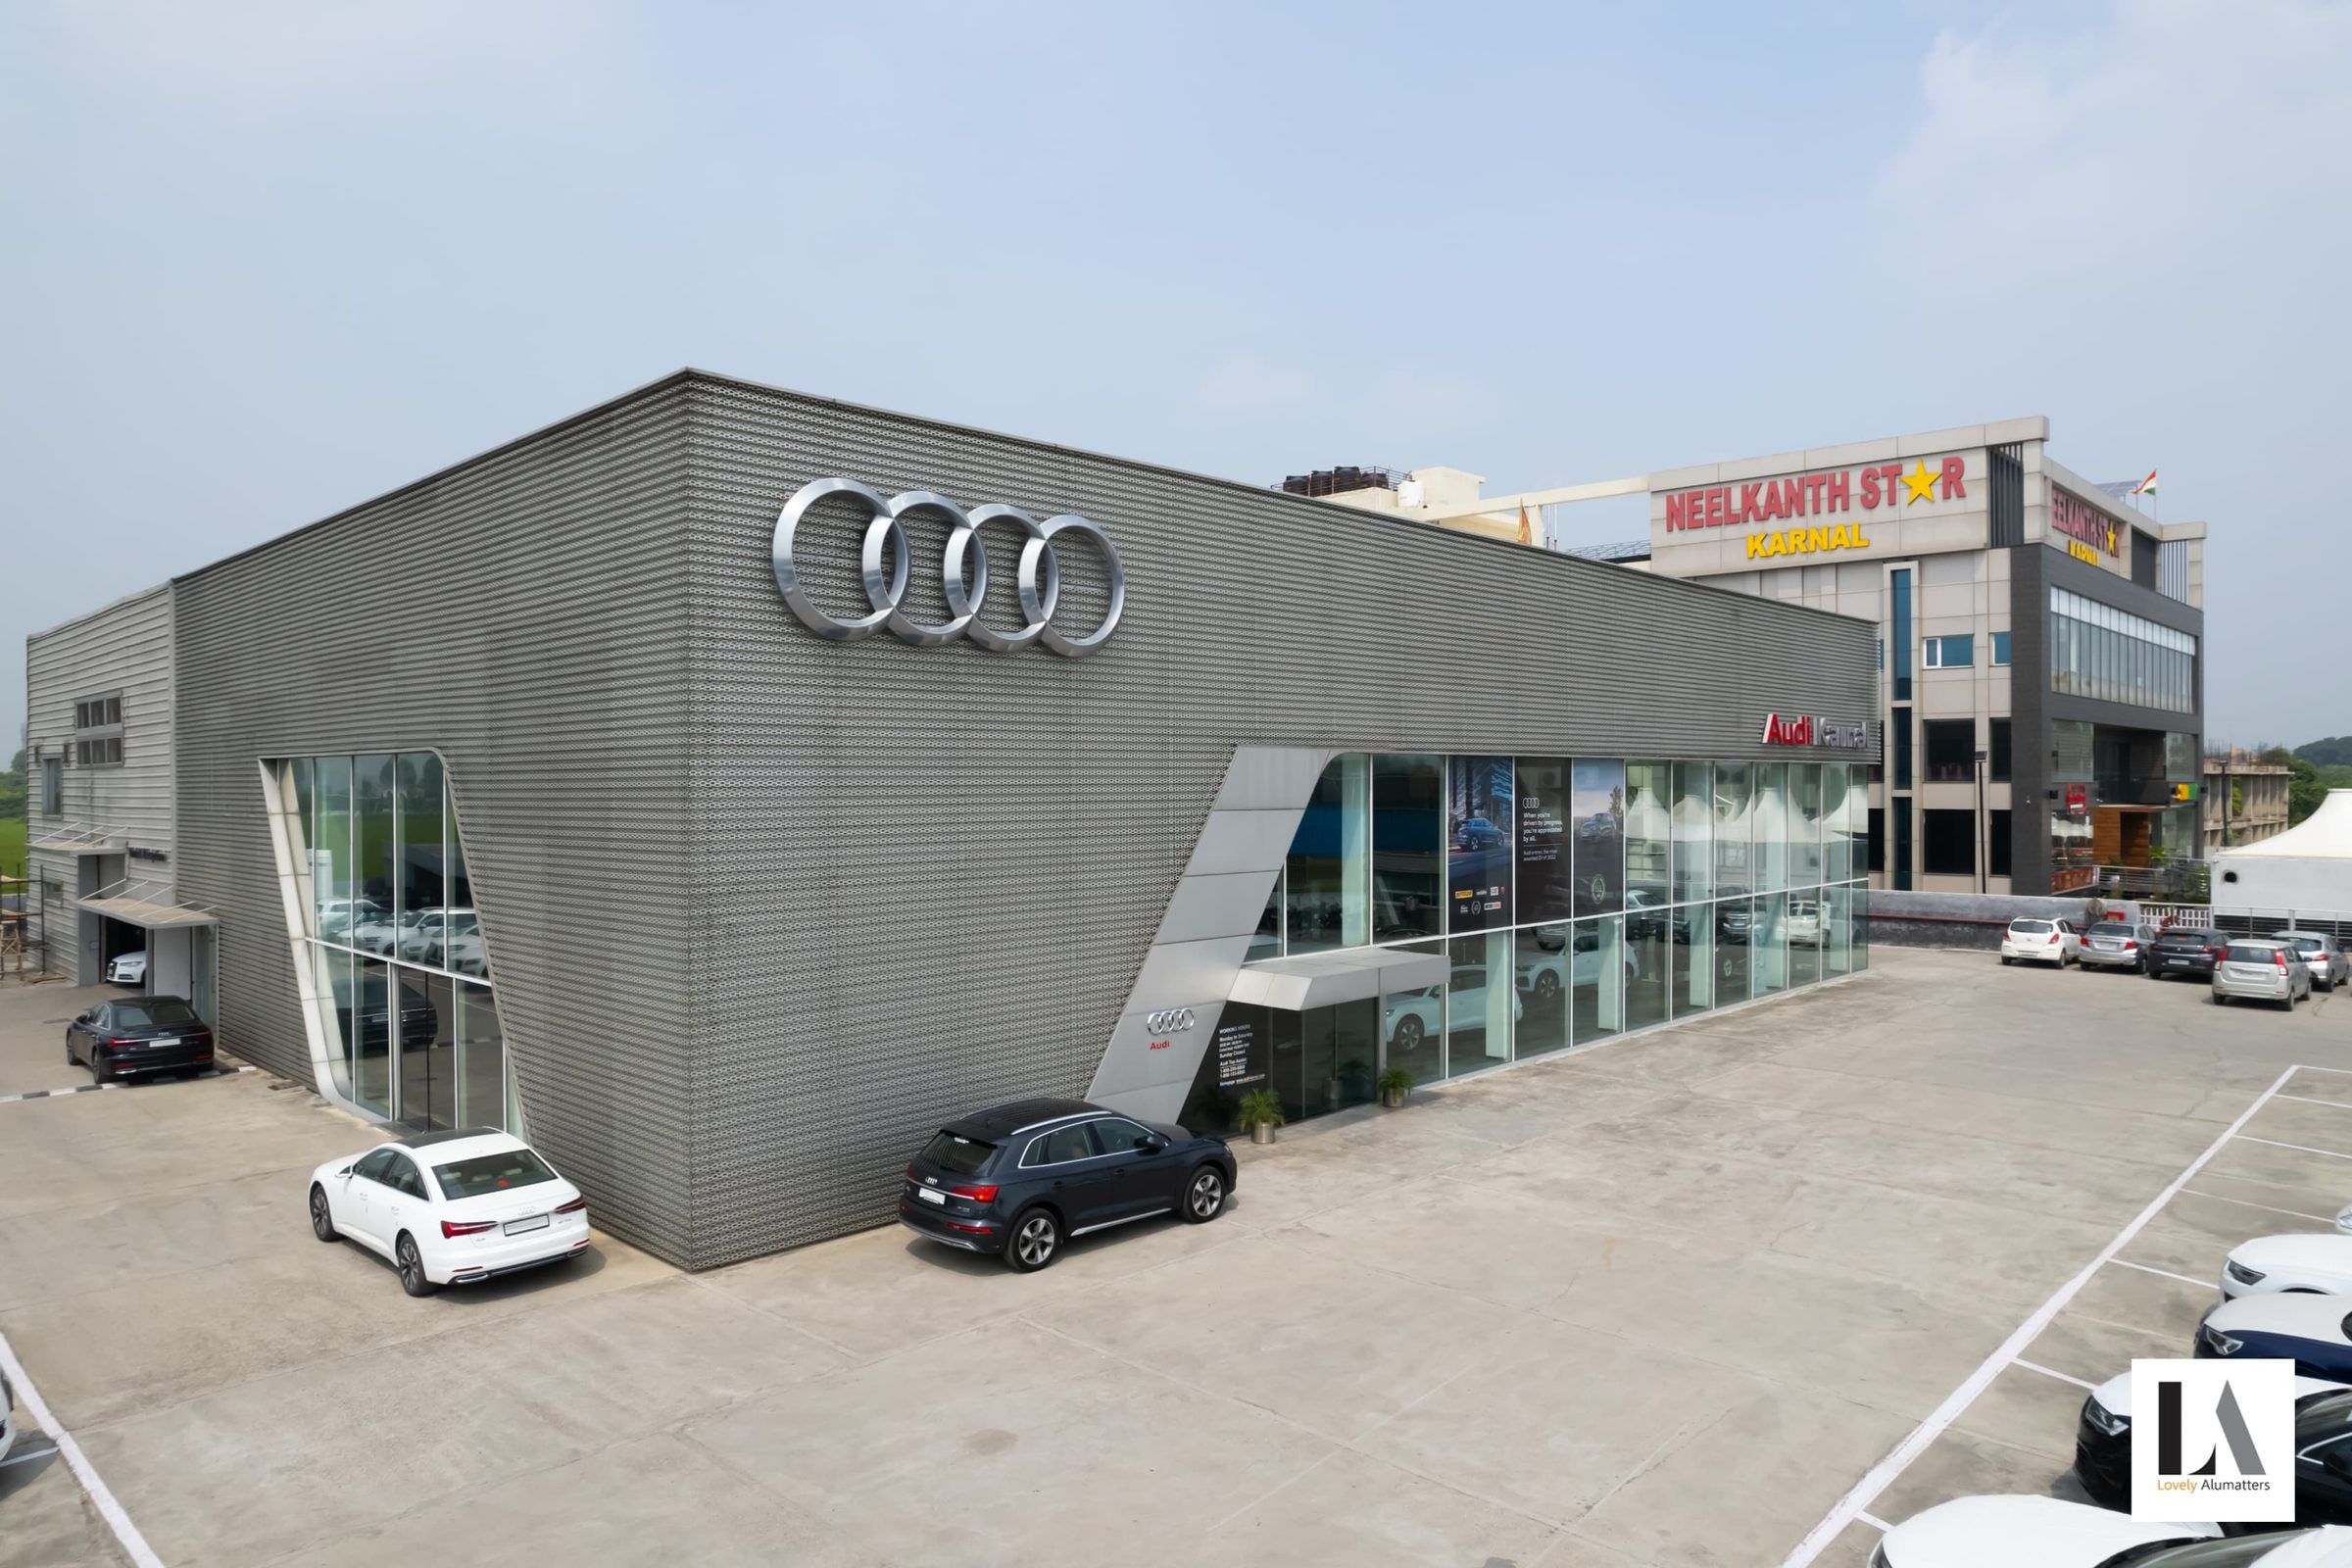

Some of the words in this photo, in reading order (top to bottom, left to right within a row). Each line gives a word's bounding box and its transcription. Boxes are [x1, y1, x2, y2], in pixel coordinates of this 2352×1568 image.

[1666, 470, 1849, 532] NEELKANTH
[1746, 522, 1870, 559] KARNAL
[1762, 713, 1812, 746] Audi
[1150, 1039, 1170, 1051] Audi
